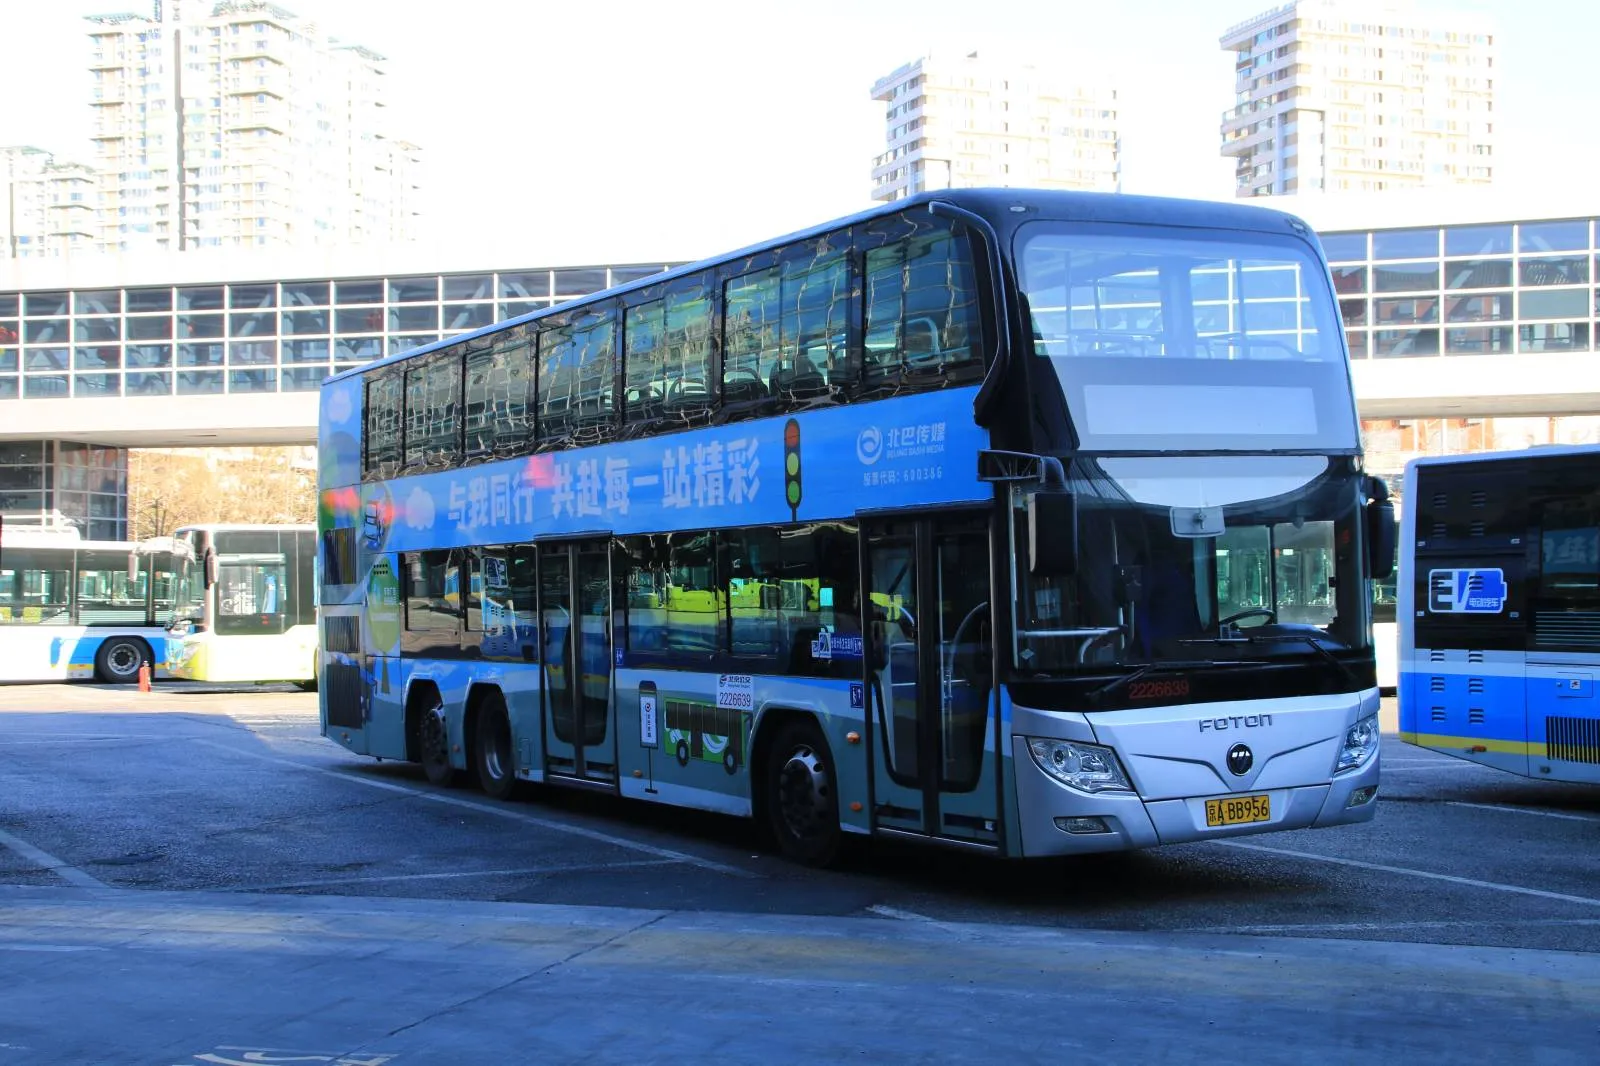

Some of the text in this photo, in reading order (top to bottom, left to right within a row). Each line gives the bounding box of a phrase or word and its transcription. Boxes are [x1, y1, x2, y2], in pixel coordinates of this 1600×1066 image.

[887, 421, 946, 448] 北巴传媒
[447, 437, 761, 531] 与我同行 共赴每一站精彩
[719, 692, 751, 707] 2226639
[1129, 679, 1190, 700] 2226639
[1199, 713, 1274, 733] FOTON
